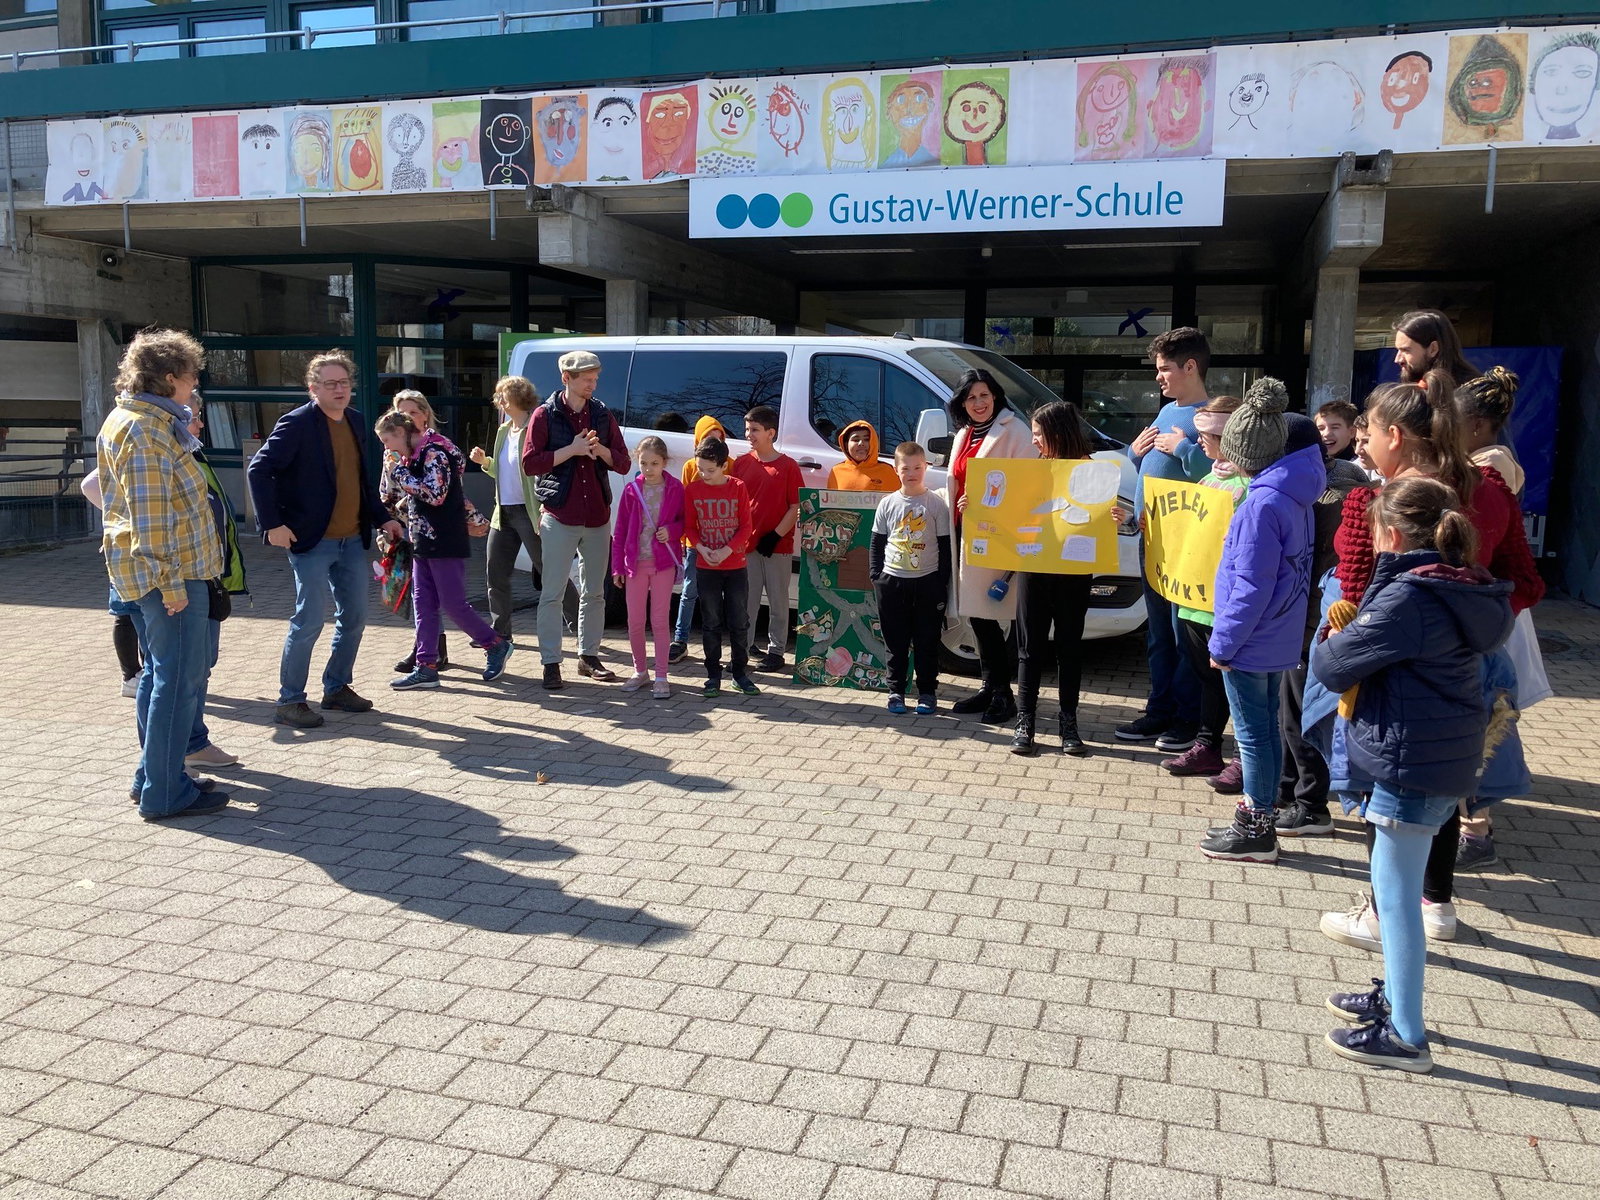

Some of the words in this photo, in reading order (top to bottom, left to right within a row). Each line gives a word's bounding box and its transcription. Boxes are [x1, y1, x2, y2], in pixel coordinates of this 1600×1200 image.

[828, 181, 1184, 224] Gustav-Werner-Schule
[1145, 490, 1209, 522] VIELEN
[1155, 563, 1208, 602] DANK!
